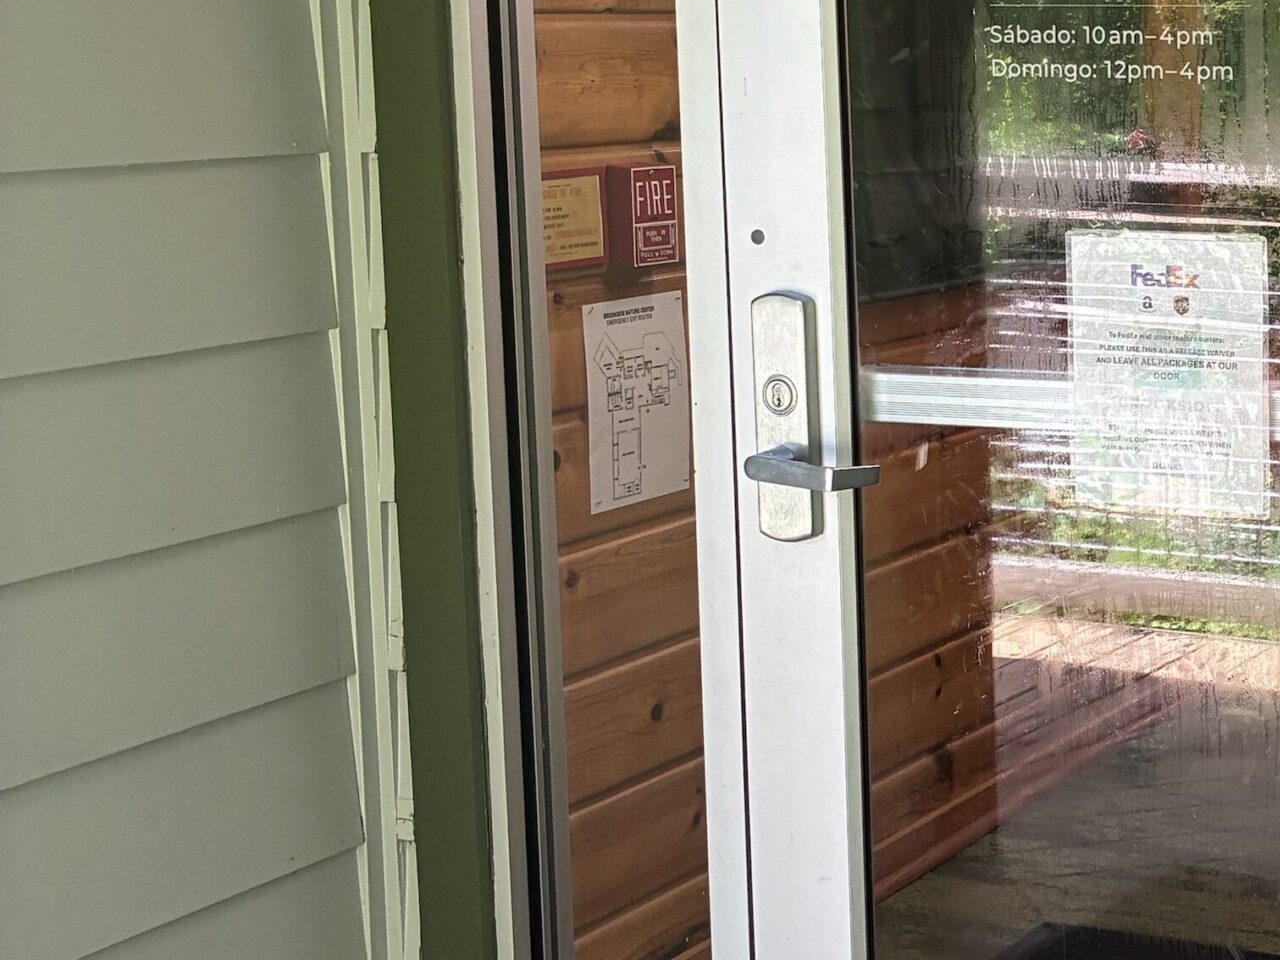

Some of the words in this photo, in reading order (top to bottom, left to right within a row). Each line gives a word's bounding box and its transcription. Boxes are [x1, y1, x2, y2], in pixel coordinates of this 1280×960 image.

[990, 24, 1076, 45] Sábado:
[991, 58, 1097, 82] Domingo:
[636, 180, 672, 216] FIRE
[1131, 264, 1200, 289] FedEx
[1099, 344, 1124, 352] PLEASE
[1142, 346, 1158, 354] THIS
[1096, 356, 1112, 364] AND
[1113, 356, 1138, 366] LEAVE
[1141, 358, 1158, 366] ALL
[1158, 358, 1204, 369] PACKAGES
[1206, 360, 1217, 369] AT
[1218, 361, 1238, 370] OUR
[1154, 372, 1180, 380] DOOR
